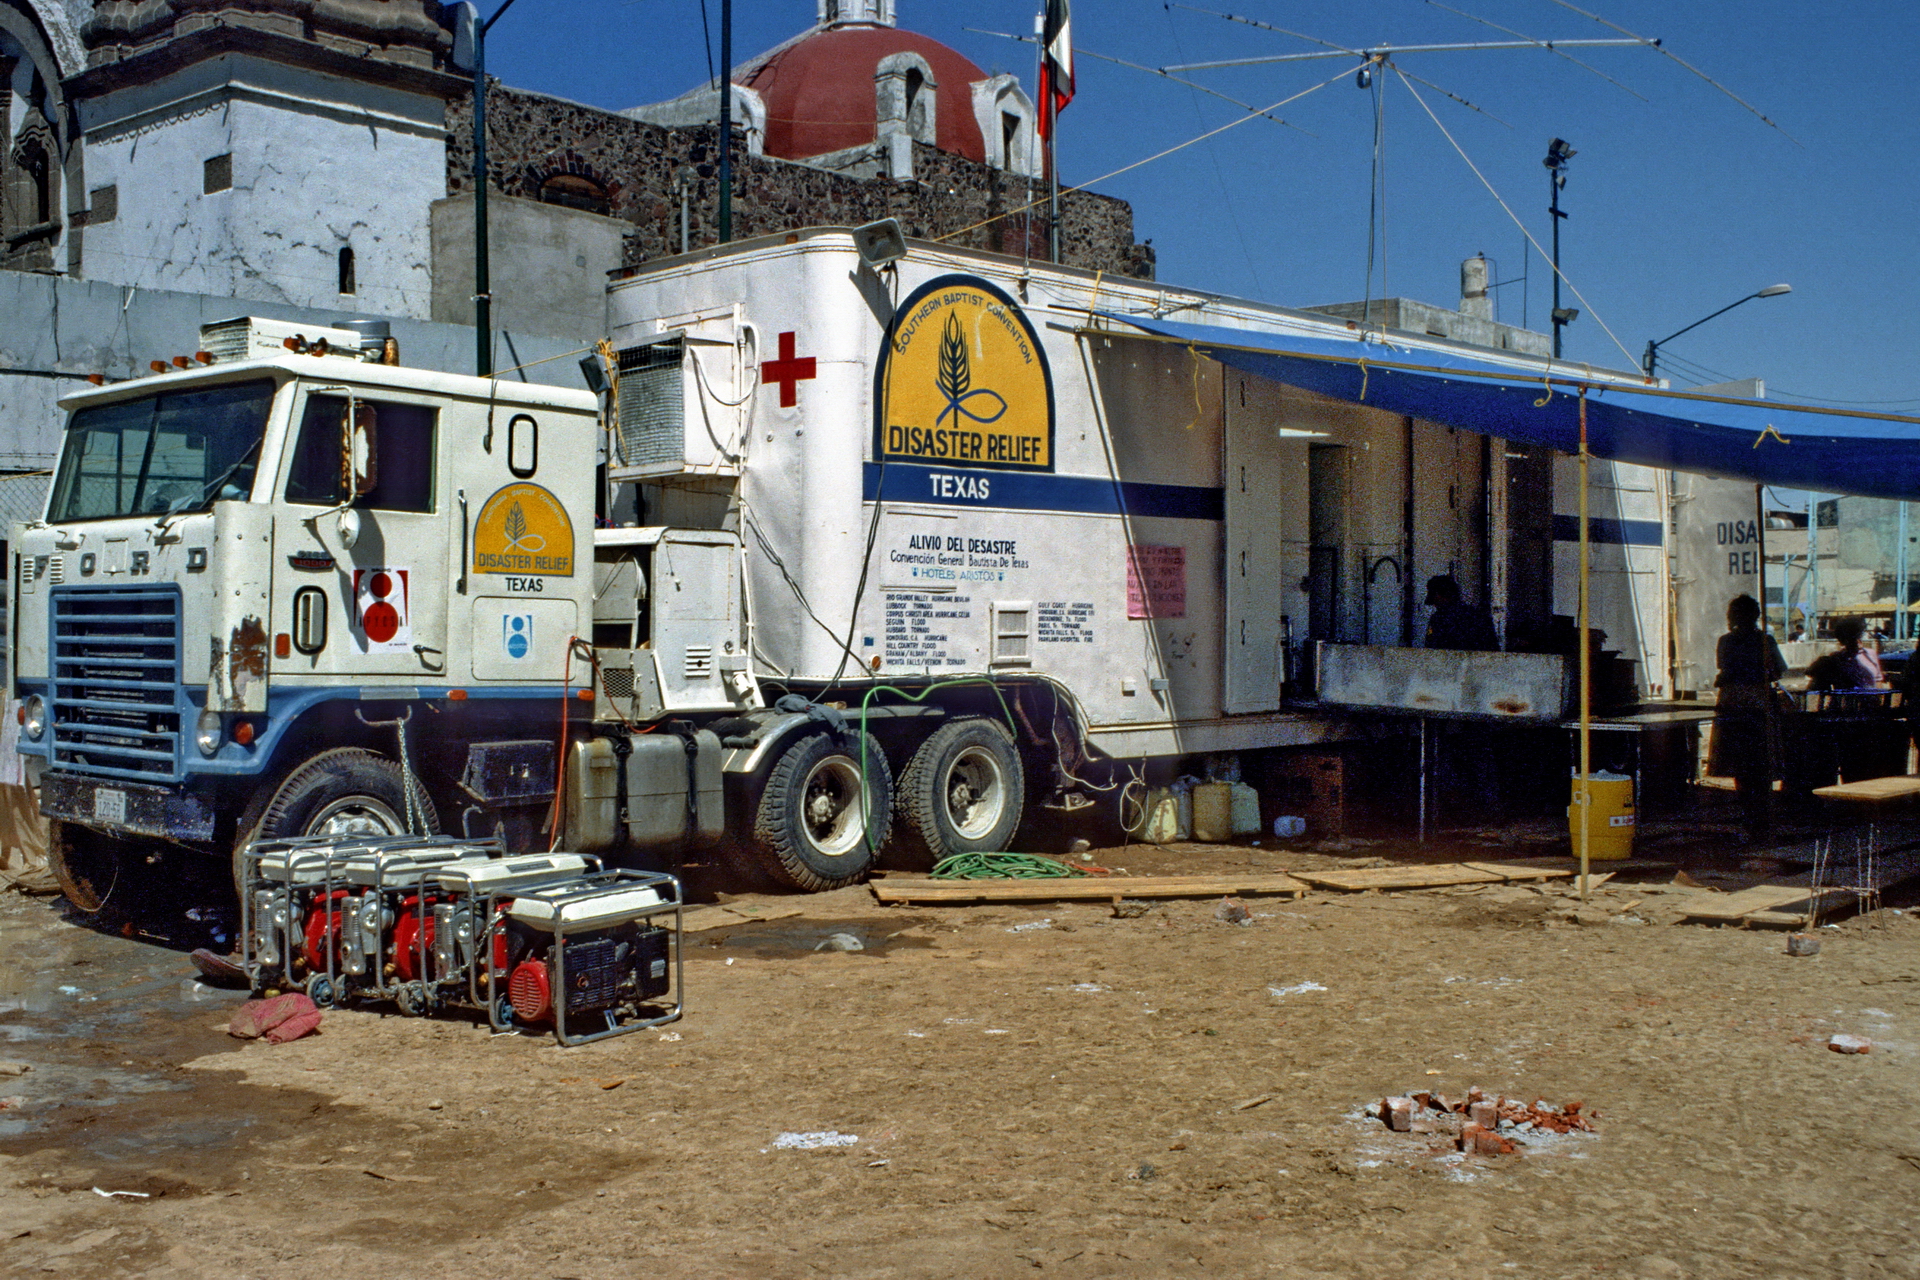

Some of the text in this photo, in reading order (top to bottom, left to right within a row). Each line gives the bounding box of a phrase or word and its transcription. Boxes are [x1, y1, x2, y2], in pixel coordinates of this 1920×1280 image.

[896, 292, 1033, 364] SOUTHERN BAPTIST CONVENTION
[889, 425, 1041, 462] DISASTER RELIEF
[929, 473, 990, 499] TEXAS
[909, 535, 1017, 555] ALIVIO DEL DESASTRE
[34, 547, 207, 578] FORD
[479, 553, 569, 571] DISASTER RELIEF
[890, 549, 935, 564] Convención
[938, 553, 965, 566] General
[969, 555, 998, 568] Bautista
[1011, 556, 1029, 569] Texas
[505, 577, 543, 592] TEXAS
[921, 568, 995, 581] HOTELES ARISTOS
